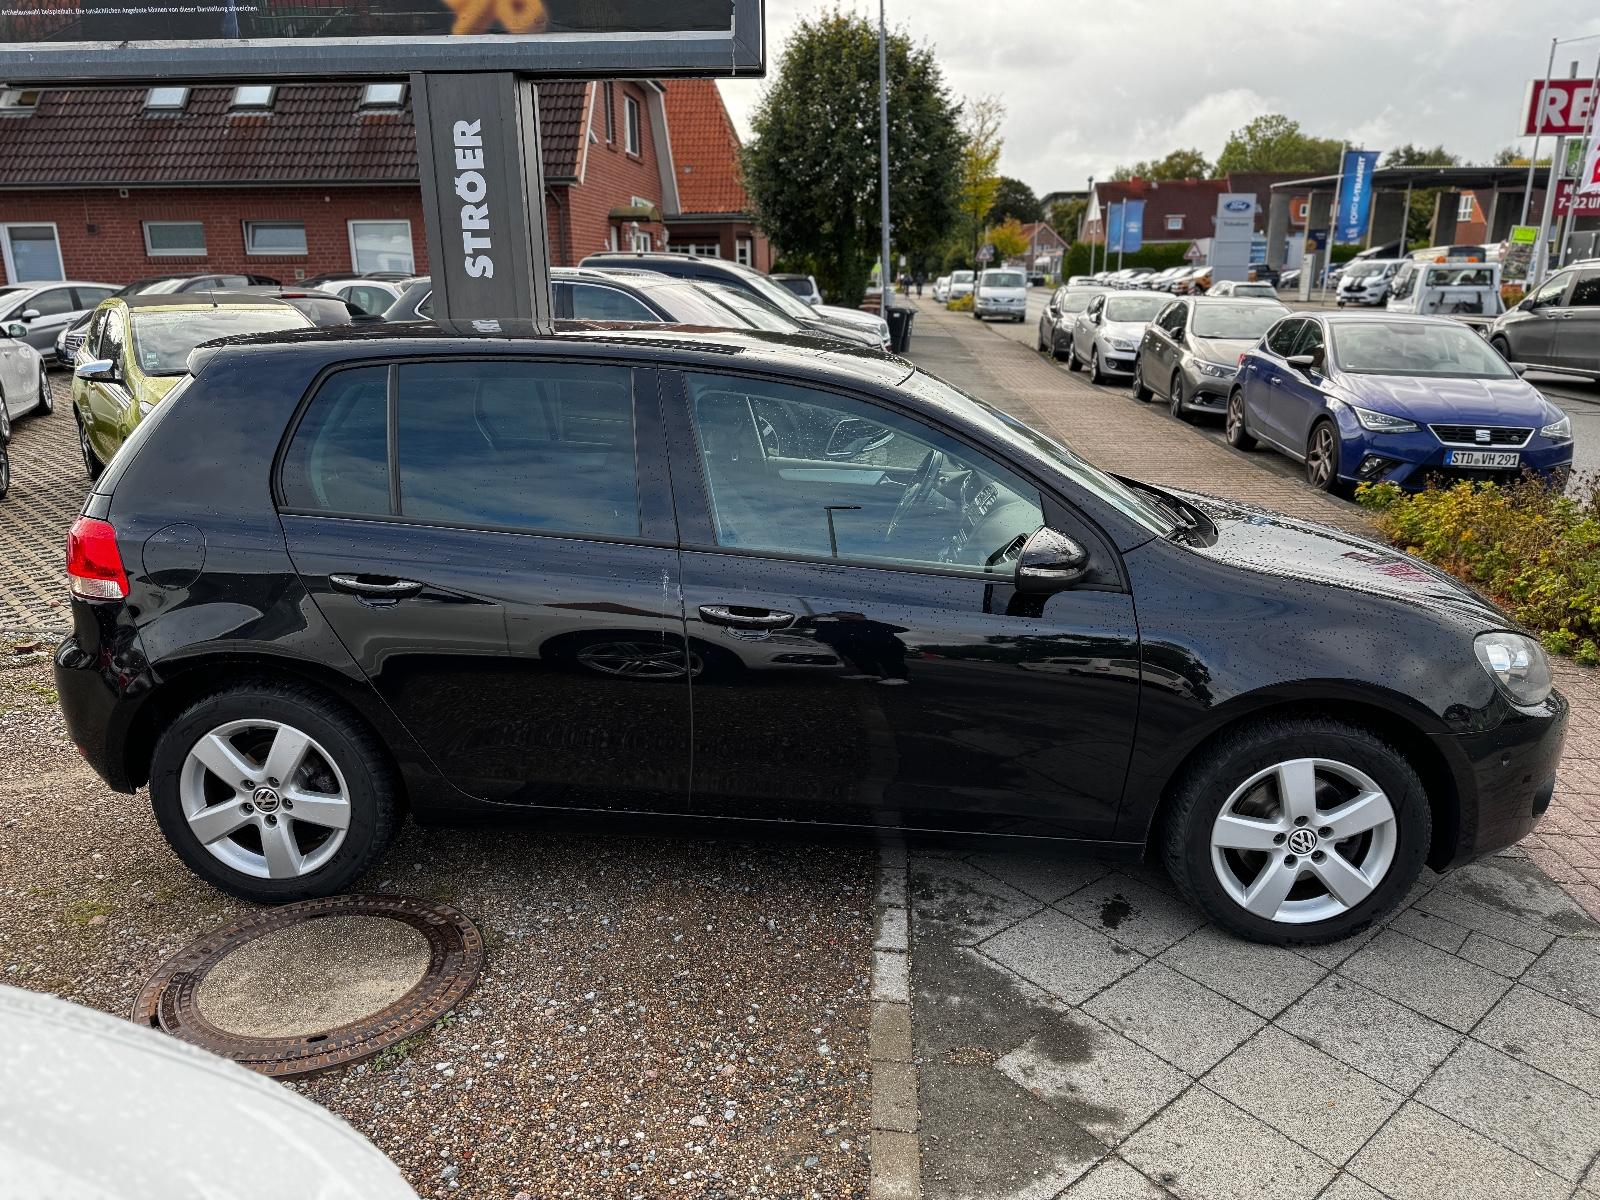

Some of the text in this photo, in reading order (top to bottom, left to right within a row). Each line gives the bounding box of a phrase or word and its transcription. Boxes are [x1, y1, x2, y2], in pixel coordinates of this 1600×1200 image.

[122, 7, 147, 15] Angebote
[197, 5, 228, 13] Darstellung
[453, 118, 494, 279] STRÖER
[1452, 453, 1518, 466] STD VH 291
